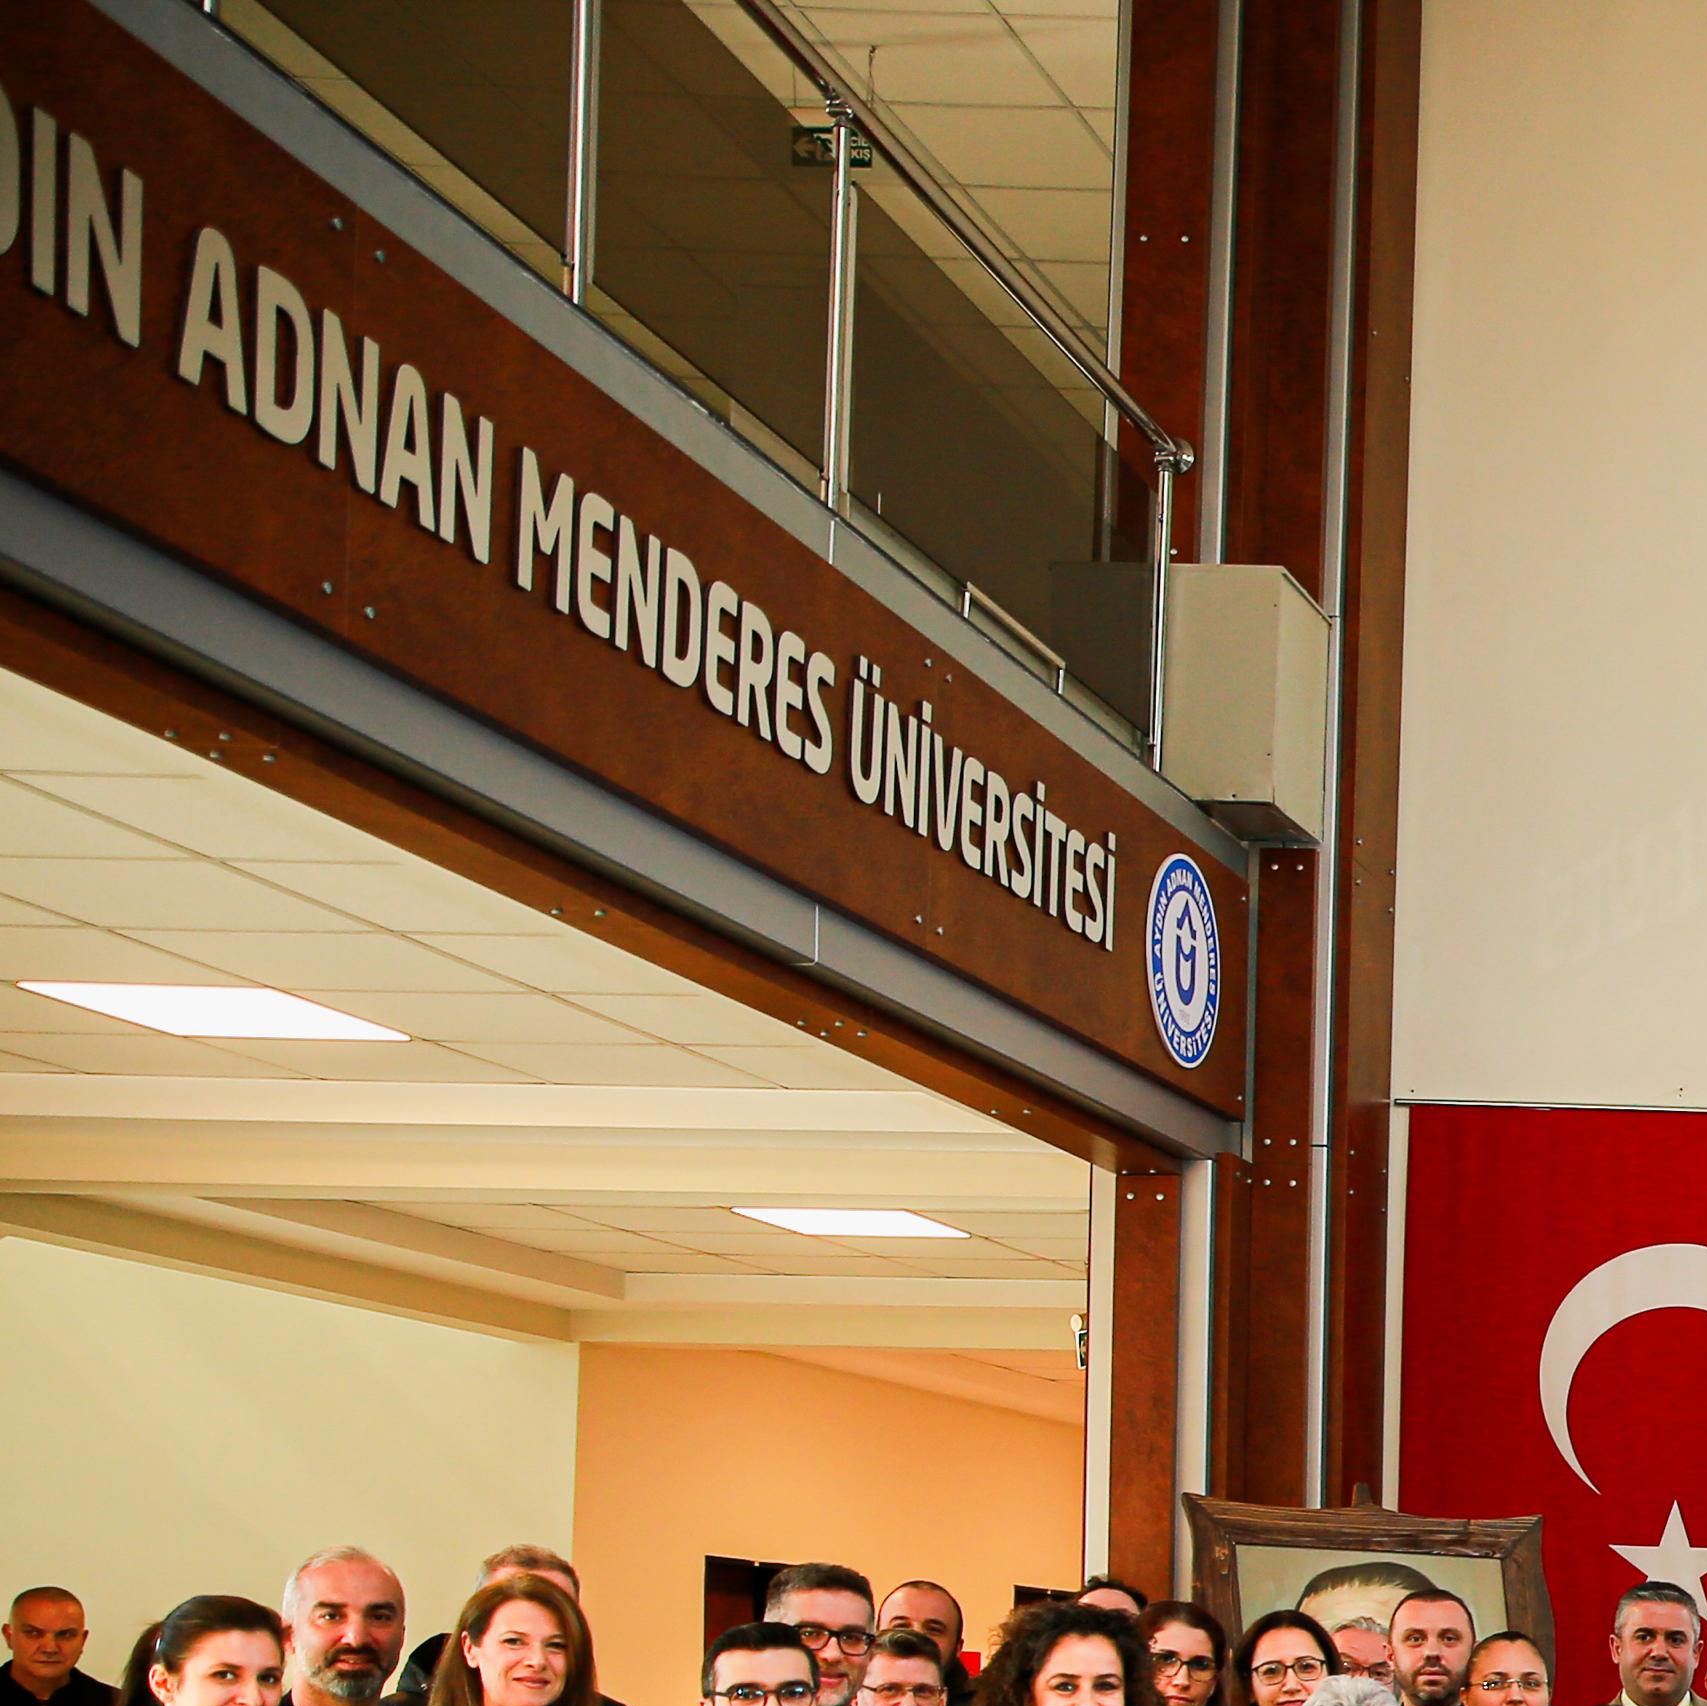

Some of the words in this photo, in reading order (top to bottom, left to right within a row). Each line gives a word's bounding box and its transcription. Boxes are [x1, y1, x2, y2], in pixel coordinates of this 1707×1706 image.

[177, 227, 494, 565] ADNAN
[514, 446, 835, 776] MENDERES
[849, 655, 1117, 952] ÜNİVERSİTESİ
[1153, 890, 1168, 959] AYDIN
[1166, 868, 1193, 897] ADNAN
